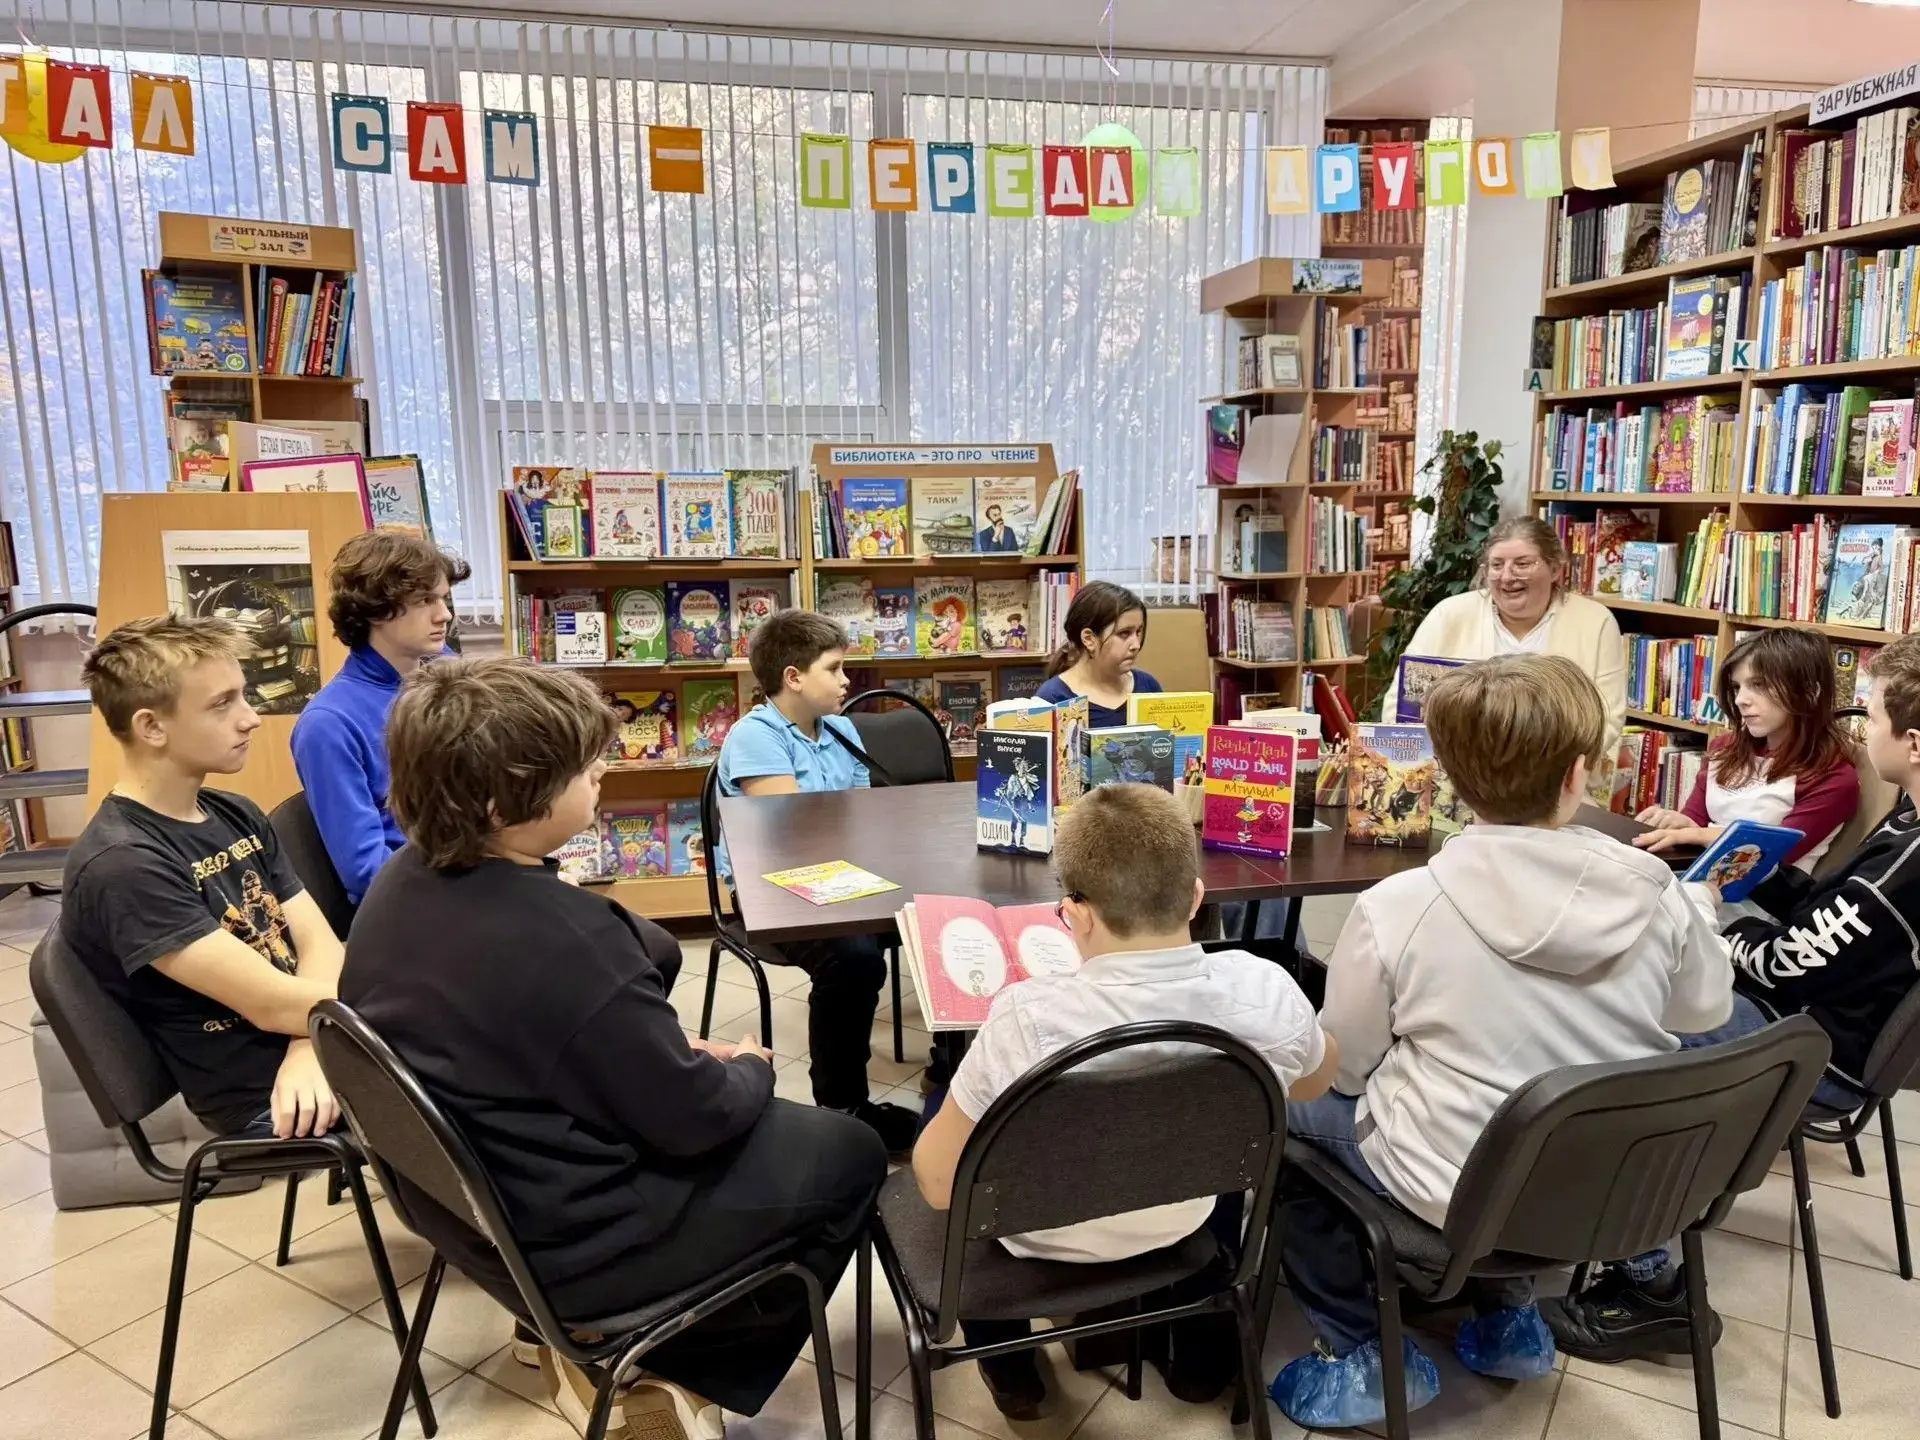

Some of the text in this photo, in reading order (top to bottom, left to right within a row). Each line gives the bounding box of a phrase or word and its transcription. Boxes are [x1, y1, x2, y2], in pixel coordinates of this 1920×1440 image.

[1816, 65, 1917, 115] ЗАРУБЕЖНАЯ
[338, 106, 537, 181] САМ
[808, 146, 1196, 209] ПЕРЕДАЙ
[1271, 138, 1605, 207] ДРУГОМУ
[232, 226, 309, 240] ЧИТАЛЬНЫЙ
[260, 241, 284, 252] ЗАЛ
[1732, 341, 1750, 367] К
[1528, 371, 1544, 391] А
[834, 449, 916, 463] БИБЛИОТЕКА
[931, 451, 955, 462] ЭТО
[957, 450, 982, 461] ПРО
[991, 449, 1036, 461] ЧТЕНИЕ
[1551, 469, 1568, 491] Б
[927, 496, 959, 504] ТАНКИ
[948, 697, 978, 705] ЕНОТИК
[1702, 696, 1725, 722] М
[993, 736, 1027, 746] НИКОЛАЙ
[997, 745, 1023, 754] ВНУКОВ
[1211, 757, 1287, 776] ROALD DAHL
[1223, 783, 1276, 798] МАТИЛЬДА
[982, 821, 1010, 842] ОДИН
